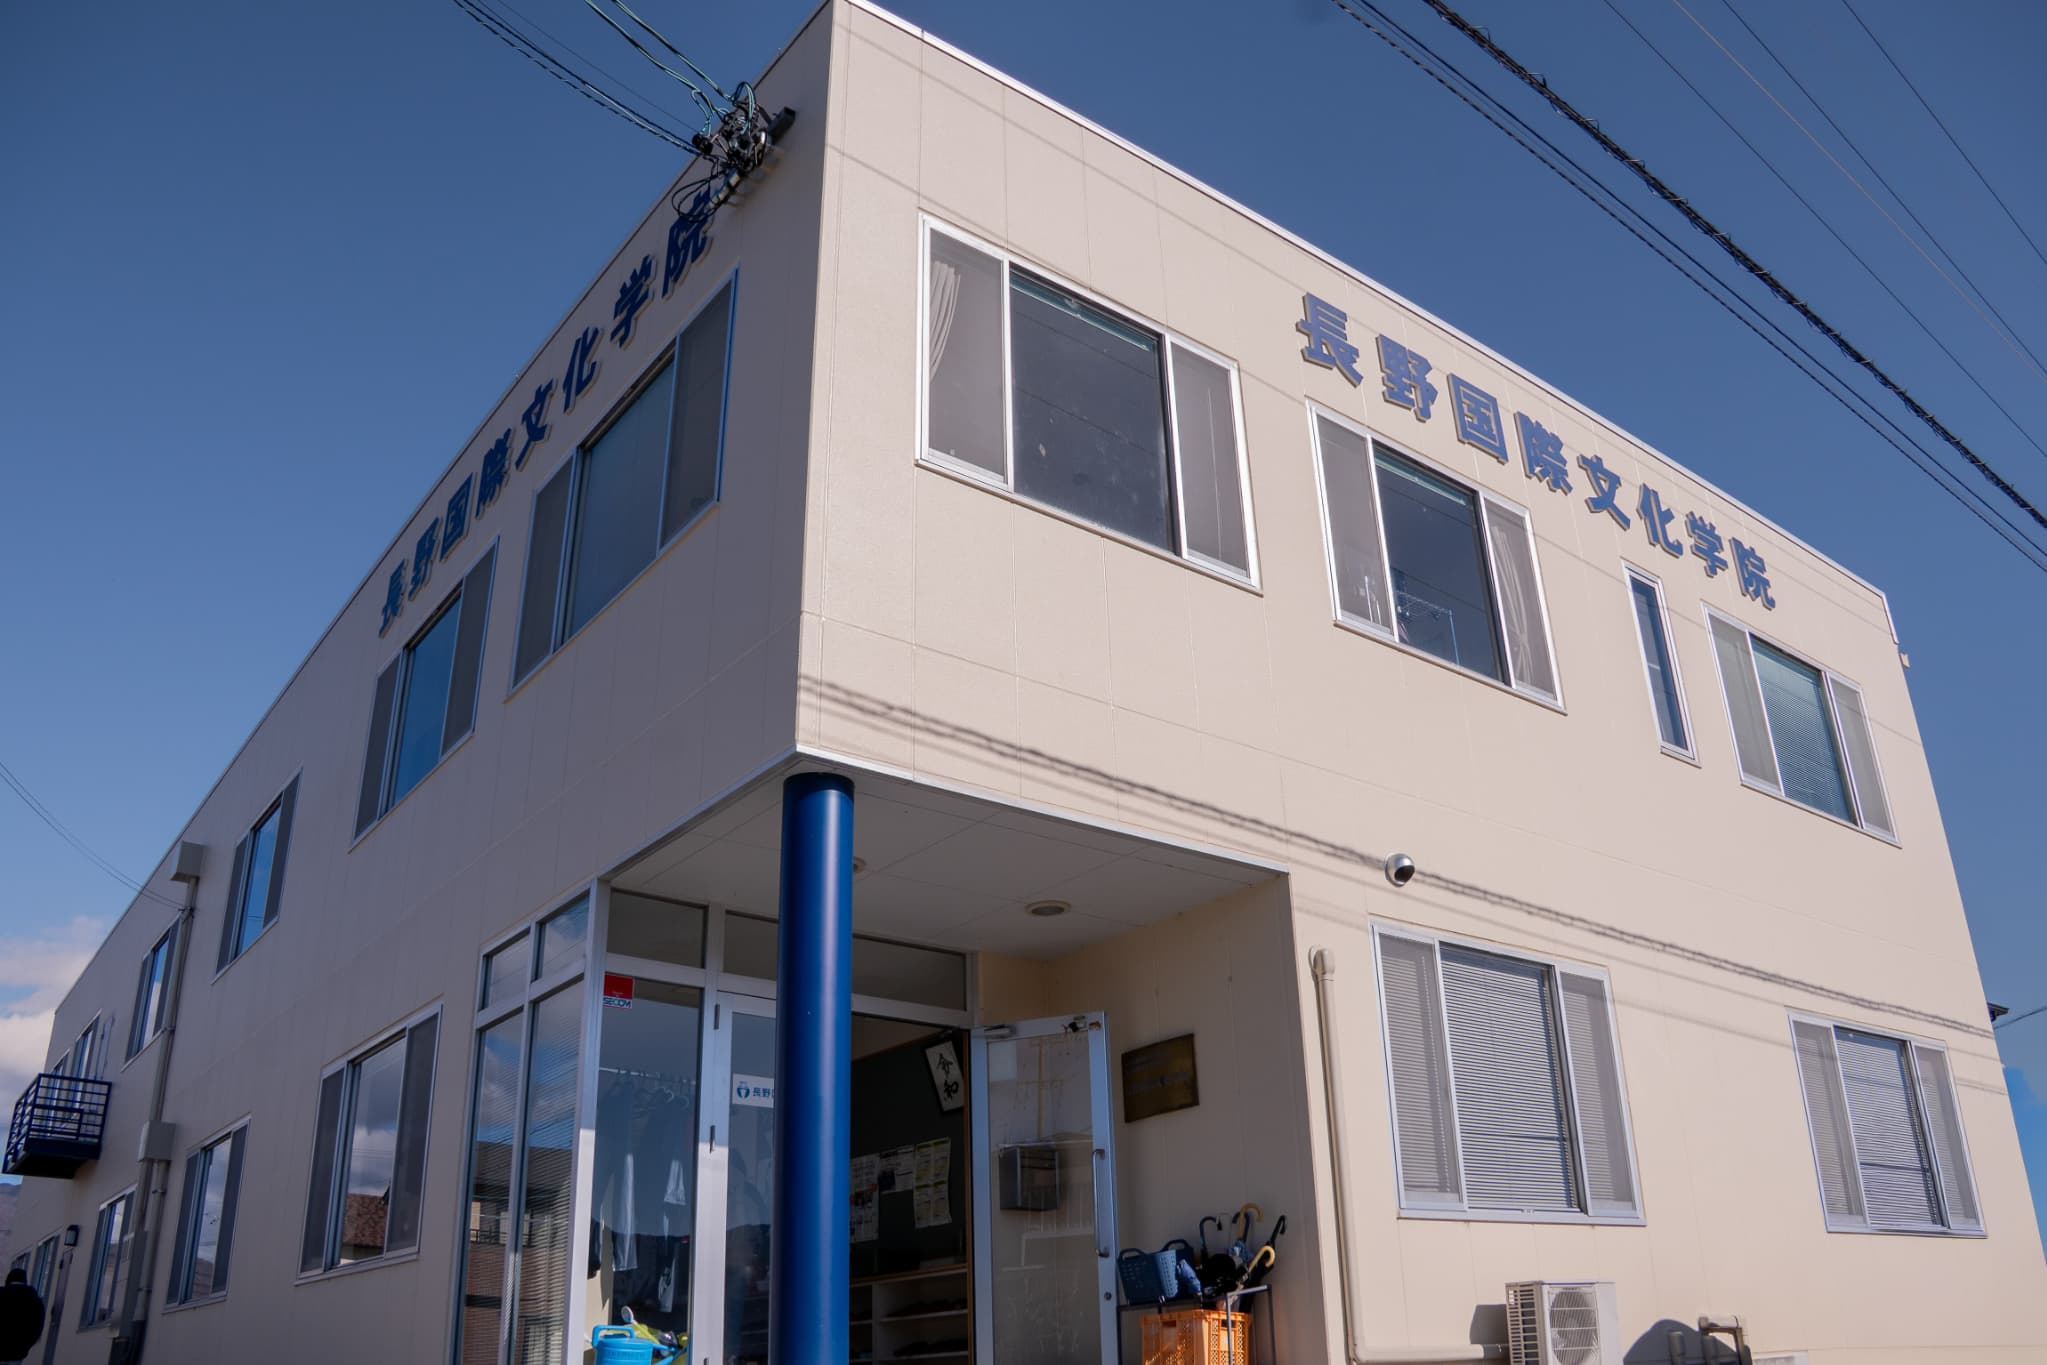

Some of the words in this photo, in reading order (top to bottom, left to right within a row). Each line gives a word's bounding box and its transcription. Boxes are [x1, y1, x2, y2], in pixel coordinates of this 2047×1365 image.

[379, 185, 714, 638] 長野国際文化学院
[1296, 292, 1776, 610] 長野国際文化学院
[602, 997, 631, 1009] SECOM
